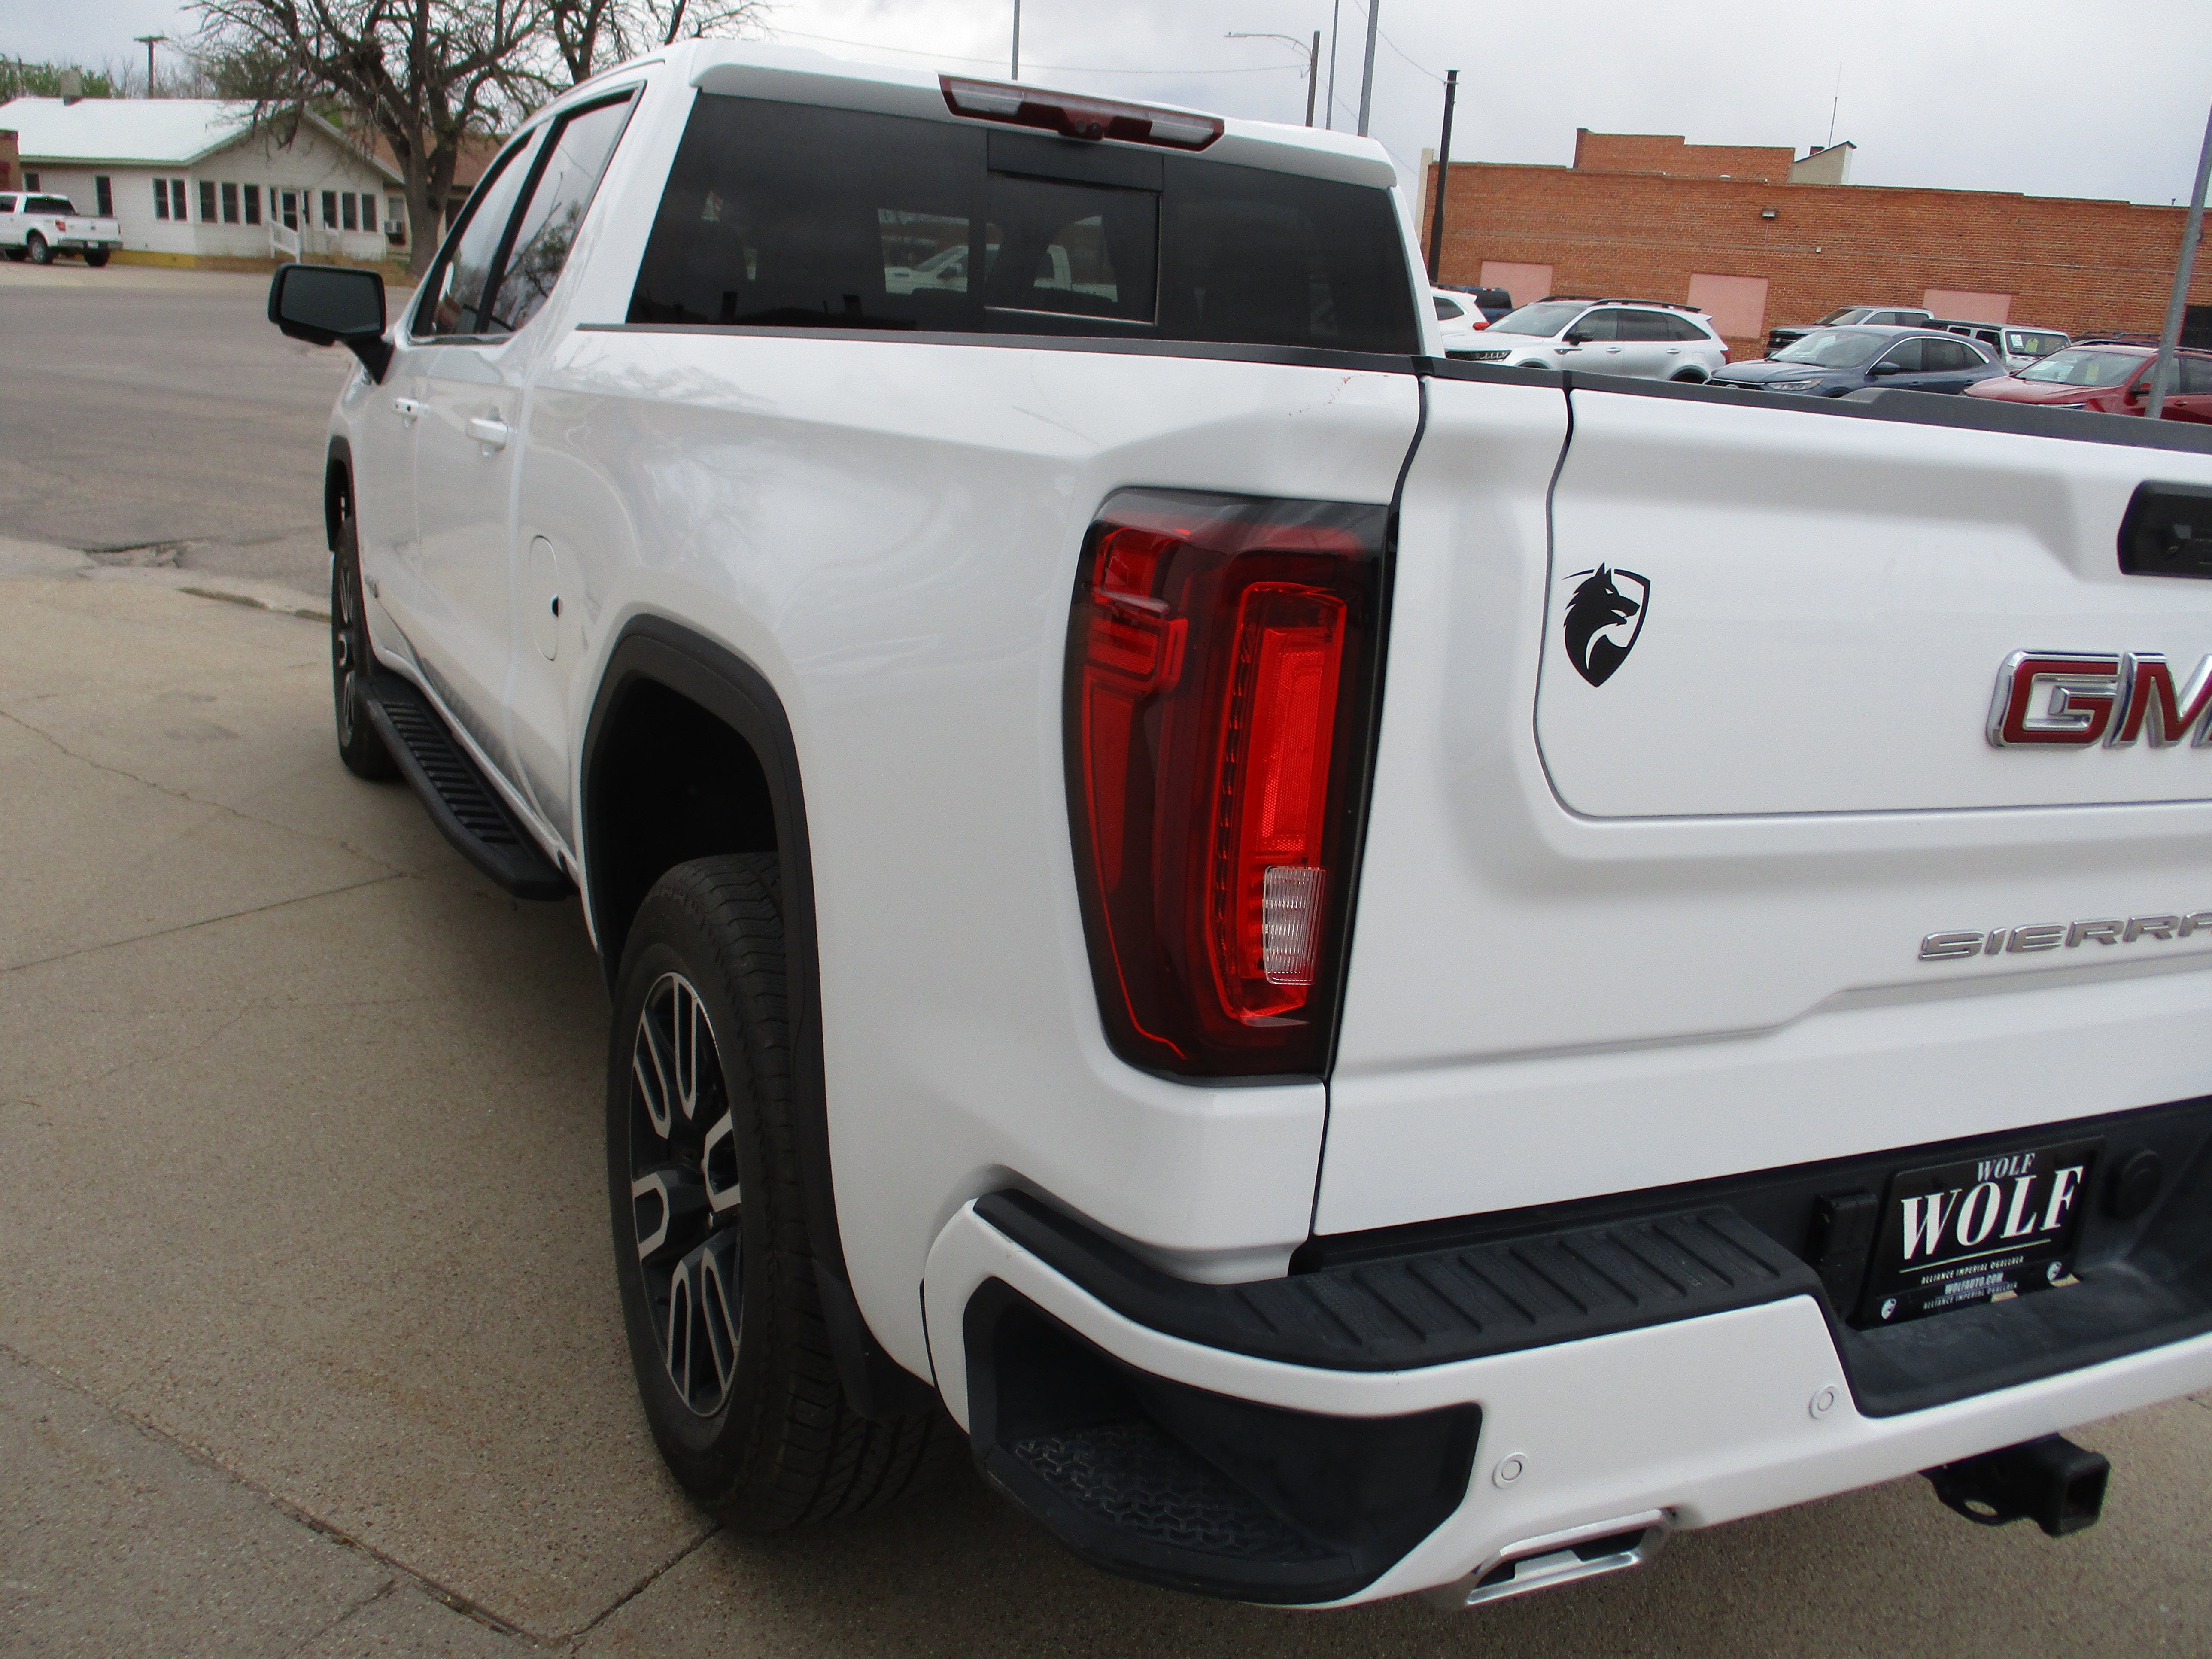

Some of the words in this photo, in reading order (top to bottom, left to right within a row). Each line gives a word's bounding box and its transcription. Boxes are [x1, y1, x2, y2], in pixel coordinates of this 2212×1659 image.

[1978, 1152, 2035, 1181] WOLF
[1901, 1165, 2084, 1260] WOLF
[1921, 1270, 1954, 1285] ALLIANCE
[1956, 1263, 1987, 1277] IMPERIAL
